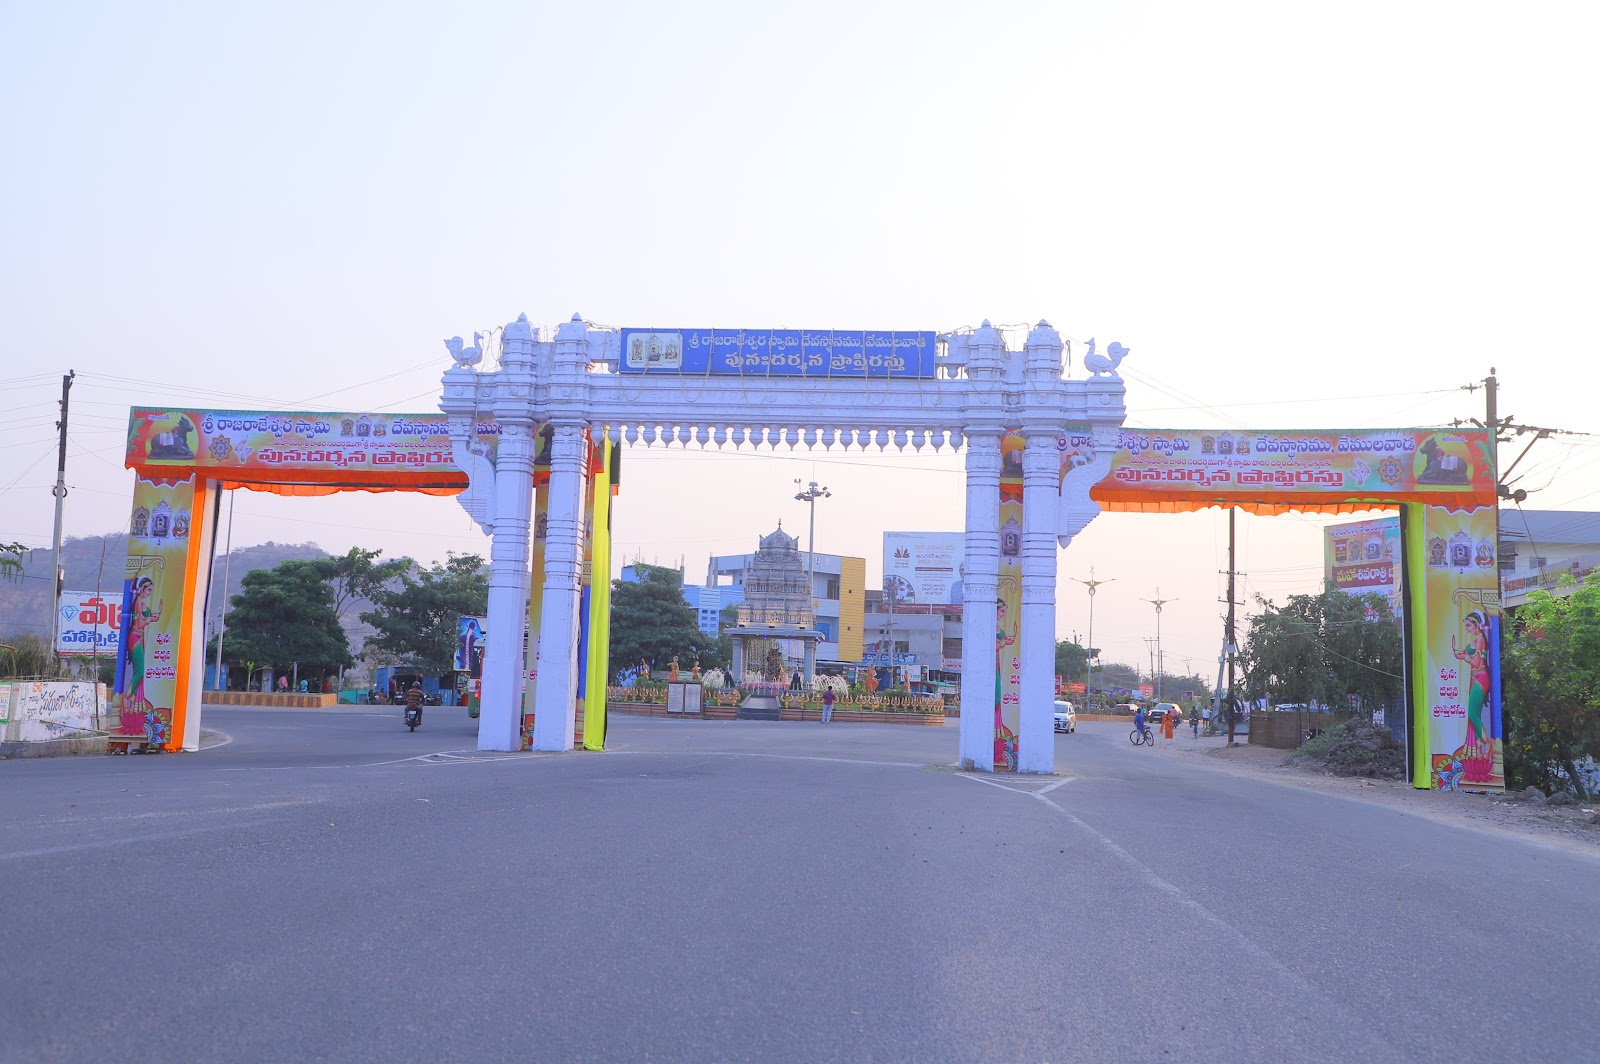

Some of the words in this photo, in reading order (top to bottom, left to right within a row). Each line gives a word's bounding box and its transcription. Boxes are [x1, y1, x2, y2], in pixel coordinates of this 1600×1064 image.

[689, 332, 700, 349] శ్రీ
[202, 414, 214, 434] శ్రీ
[217, 416, 293, 438] రాజరాజేశ్వర
[295, 419, 330, 438] స్వామి
[1153, 436, 1190, 456] స్వామి
[1338, 435, 1416, 452] వేములవాడ
[1237, 469, 1343, 487] ప్రాప్తిరస్తు
